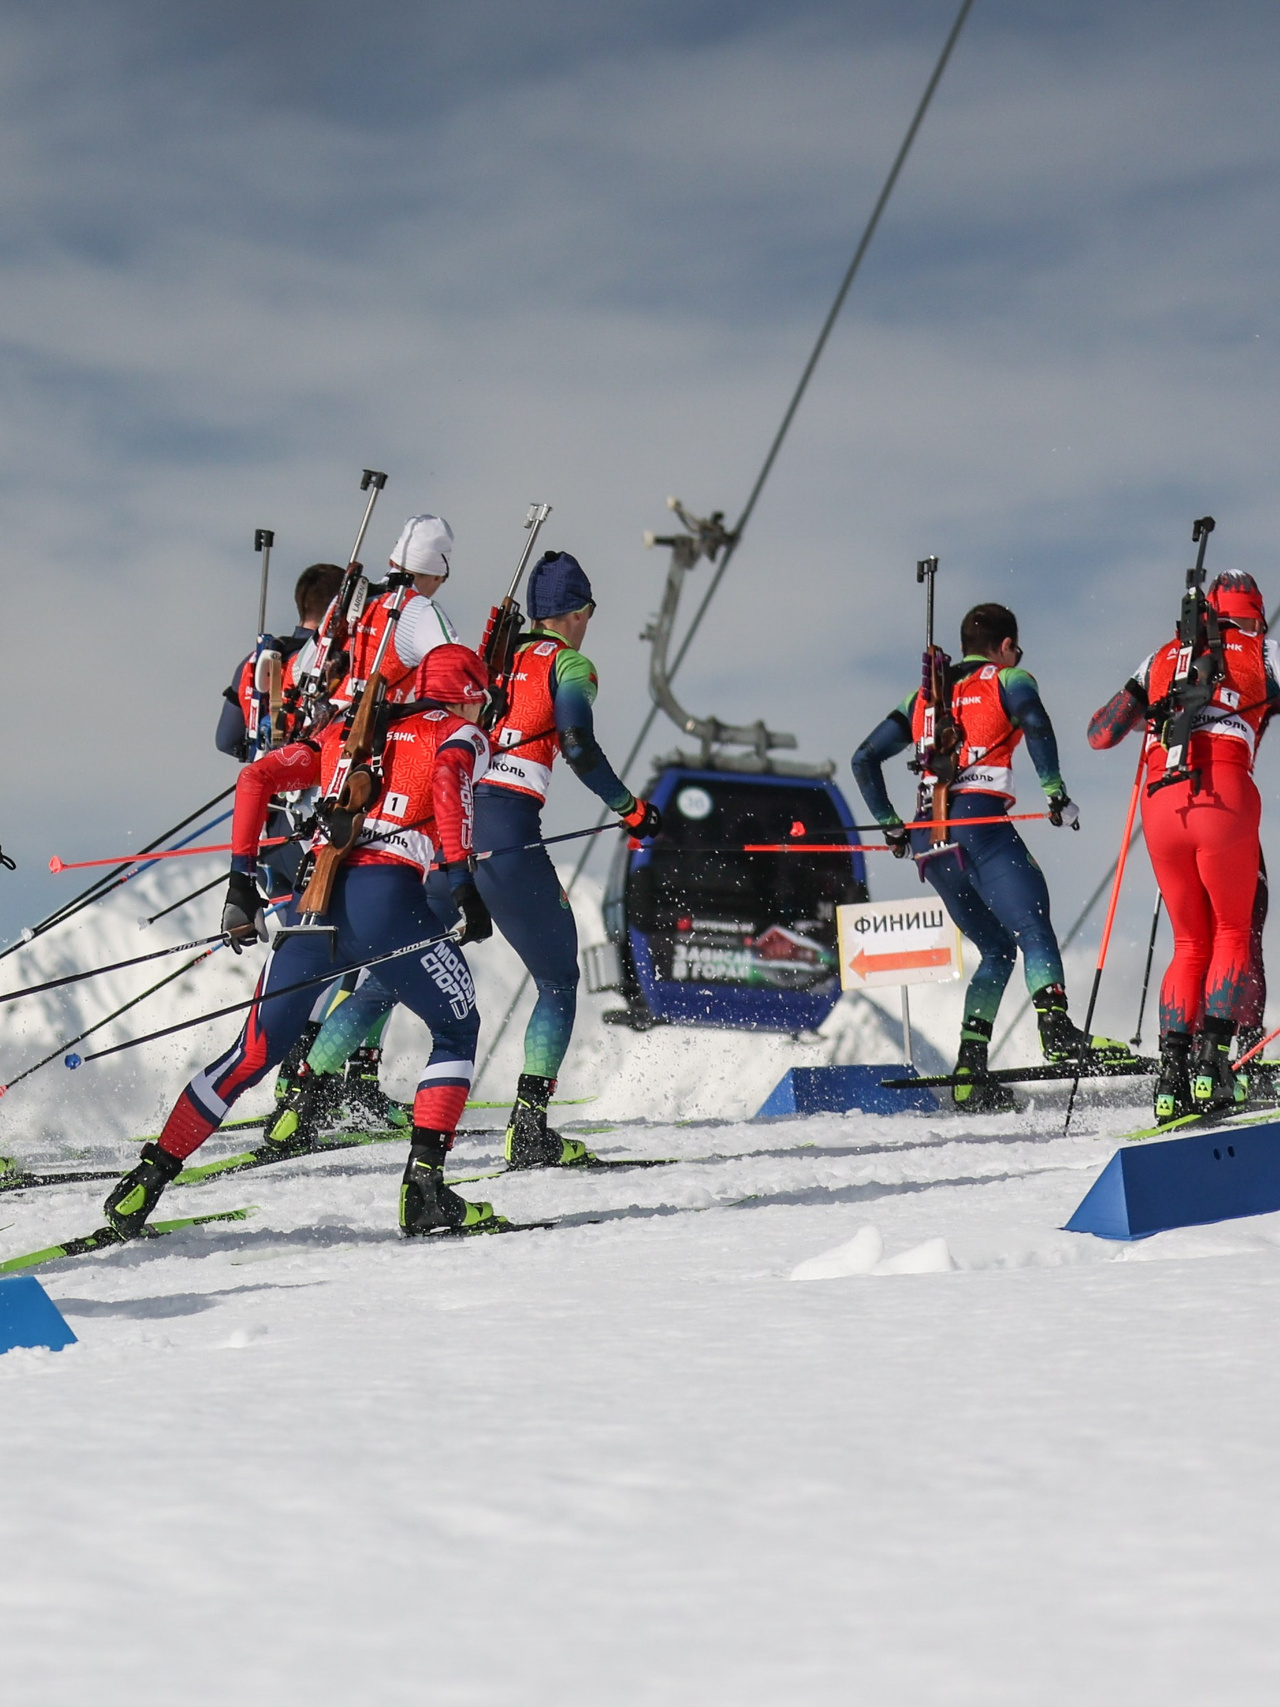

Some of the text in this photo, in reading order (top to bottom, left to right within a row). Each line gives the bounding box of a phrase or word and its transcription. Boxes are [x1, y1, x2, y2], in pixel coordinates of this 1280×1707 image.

[507, 731, 512, 745] 1
[391, 797, 399, 811] 1
[854, 909, 943, 935] ФИНИШ
